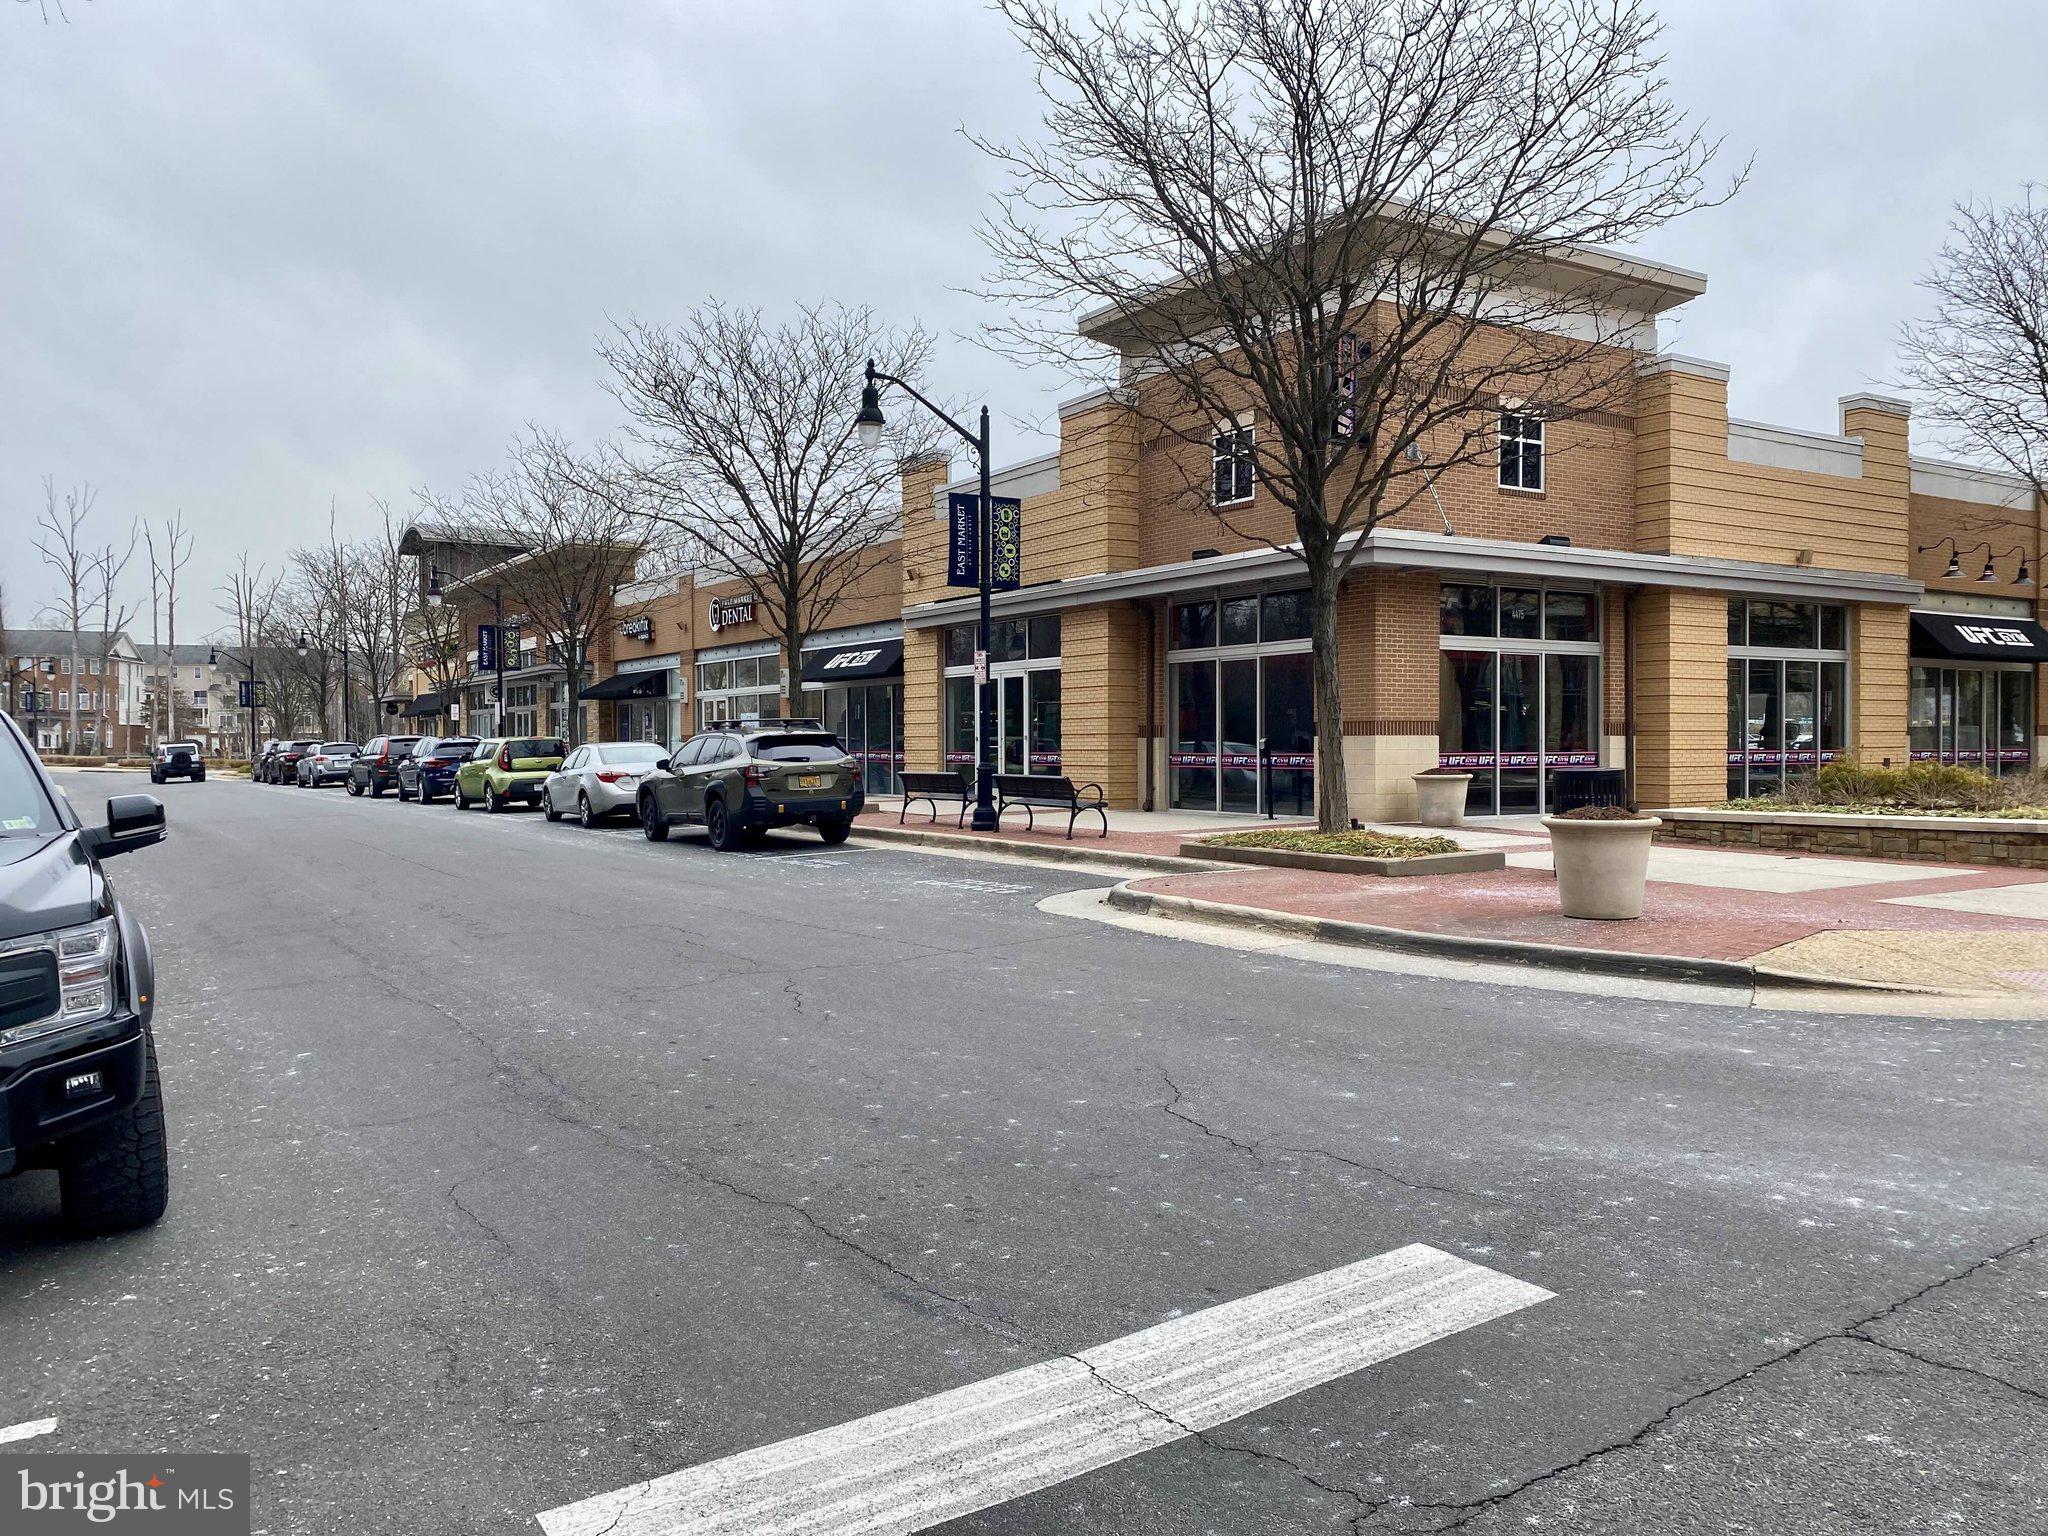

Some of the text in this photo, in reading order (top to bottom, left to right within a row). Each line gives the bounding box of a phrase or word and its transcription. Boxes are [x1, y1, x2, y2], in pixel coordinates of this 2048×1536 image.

[956, 504, 966, 575] EAST MARKET
[722, 605, 752, 626] DENTAL
[1512, 610, 1524, 619] 4475
[1954, 624, 2032, 645] UFC GYM
[824, 652, 860, 669] UFC
[1289, 757, 1305, 765] UFC
[1449, 756, 1465, 765] UFC
[1511, 756, 1526, 764] UFC
[1570, 755, 1584, 763] UFC
